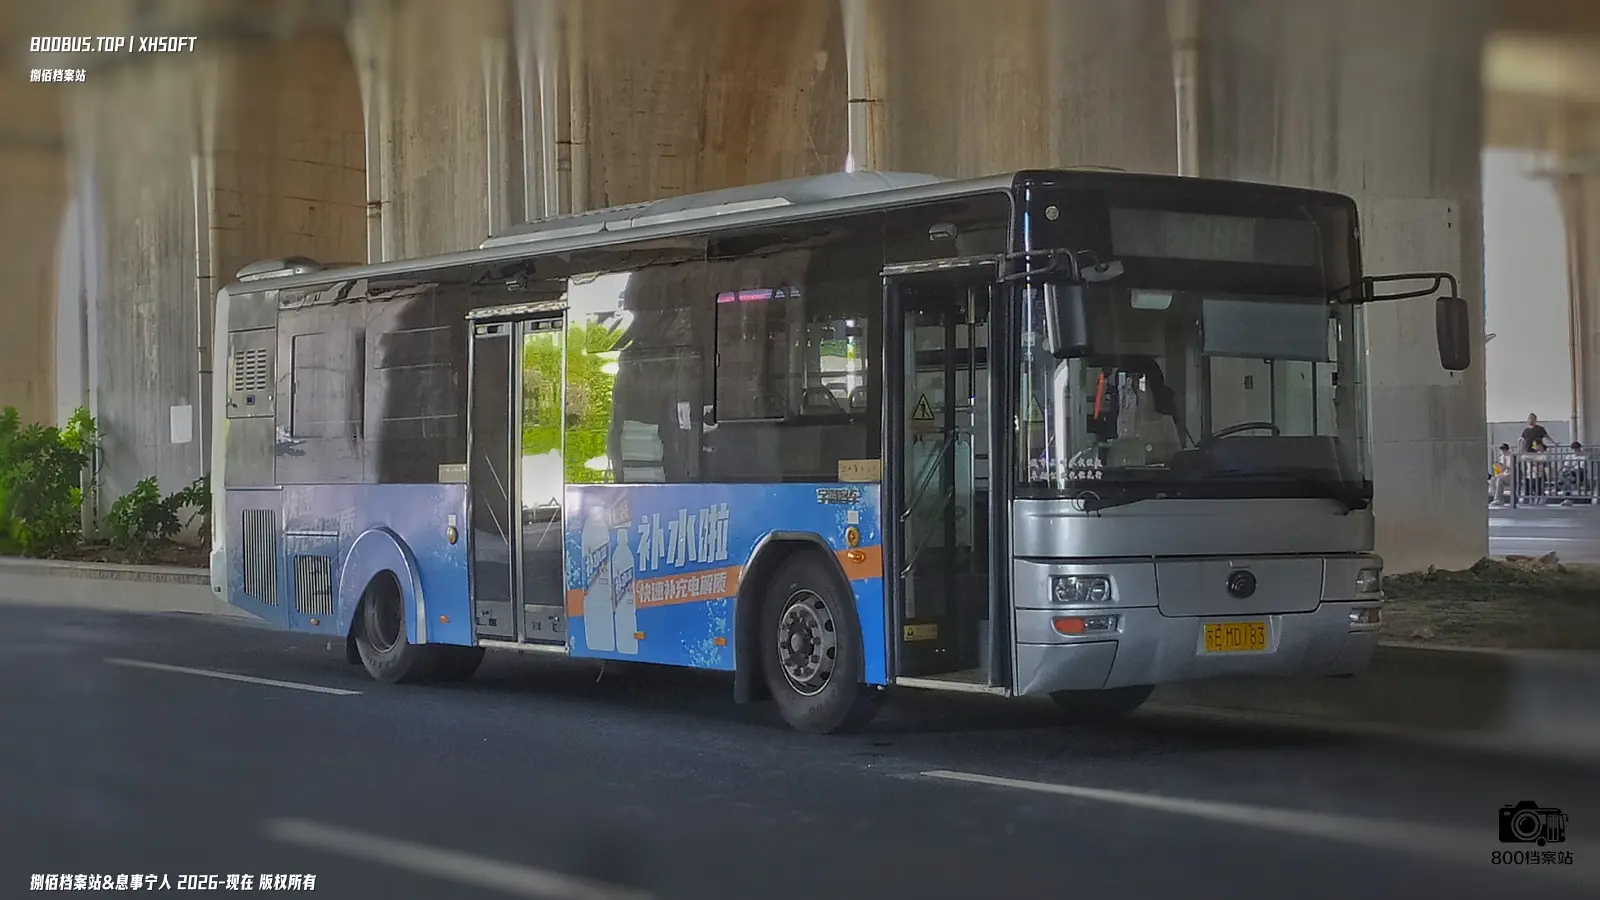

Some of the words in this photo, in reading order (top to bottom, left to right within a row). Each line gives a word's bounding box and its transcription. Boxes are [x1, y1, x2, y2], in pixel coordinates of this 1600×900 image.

[636, 503, 730, 571] 补水啦
[638, 571, 727, 603] 快速补充电解质
